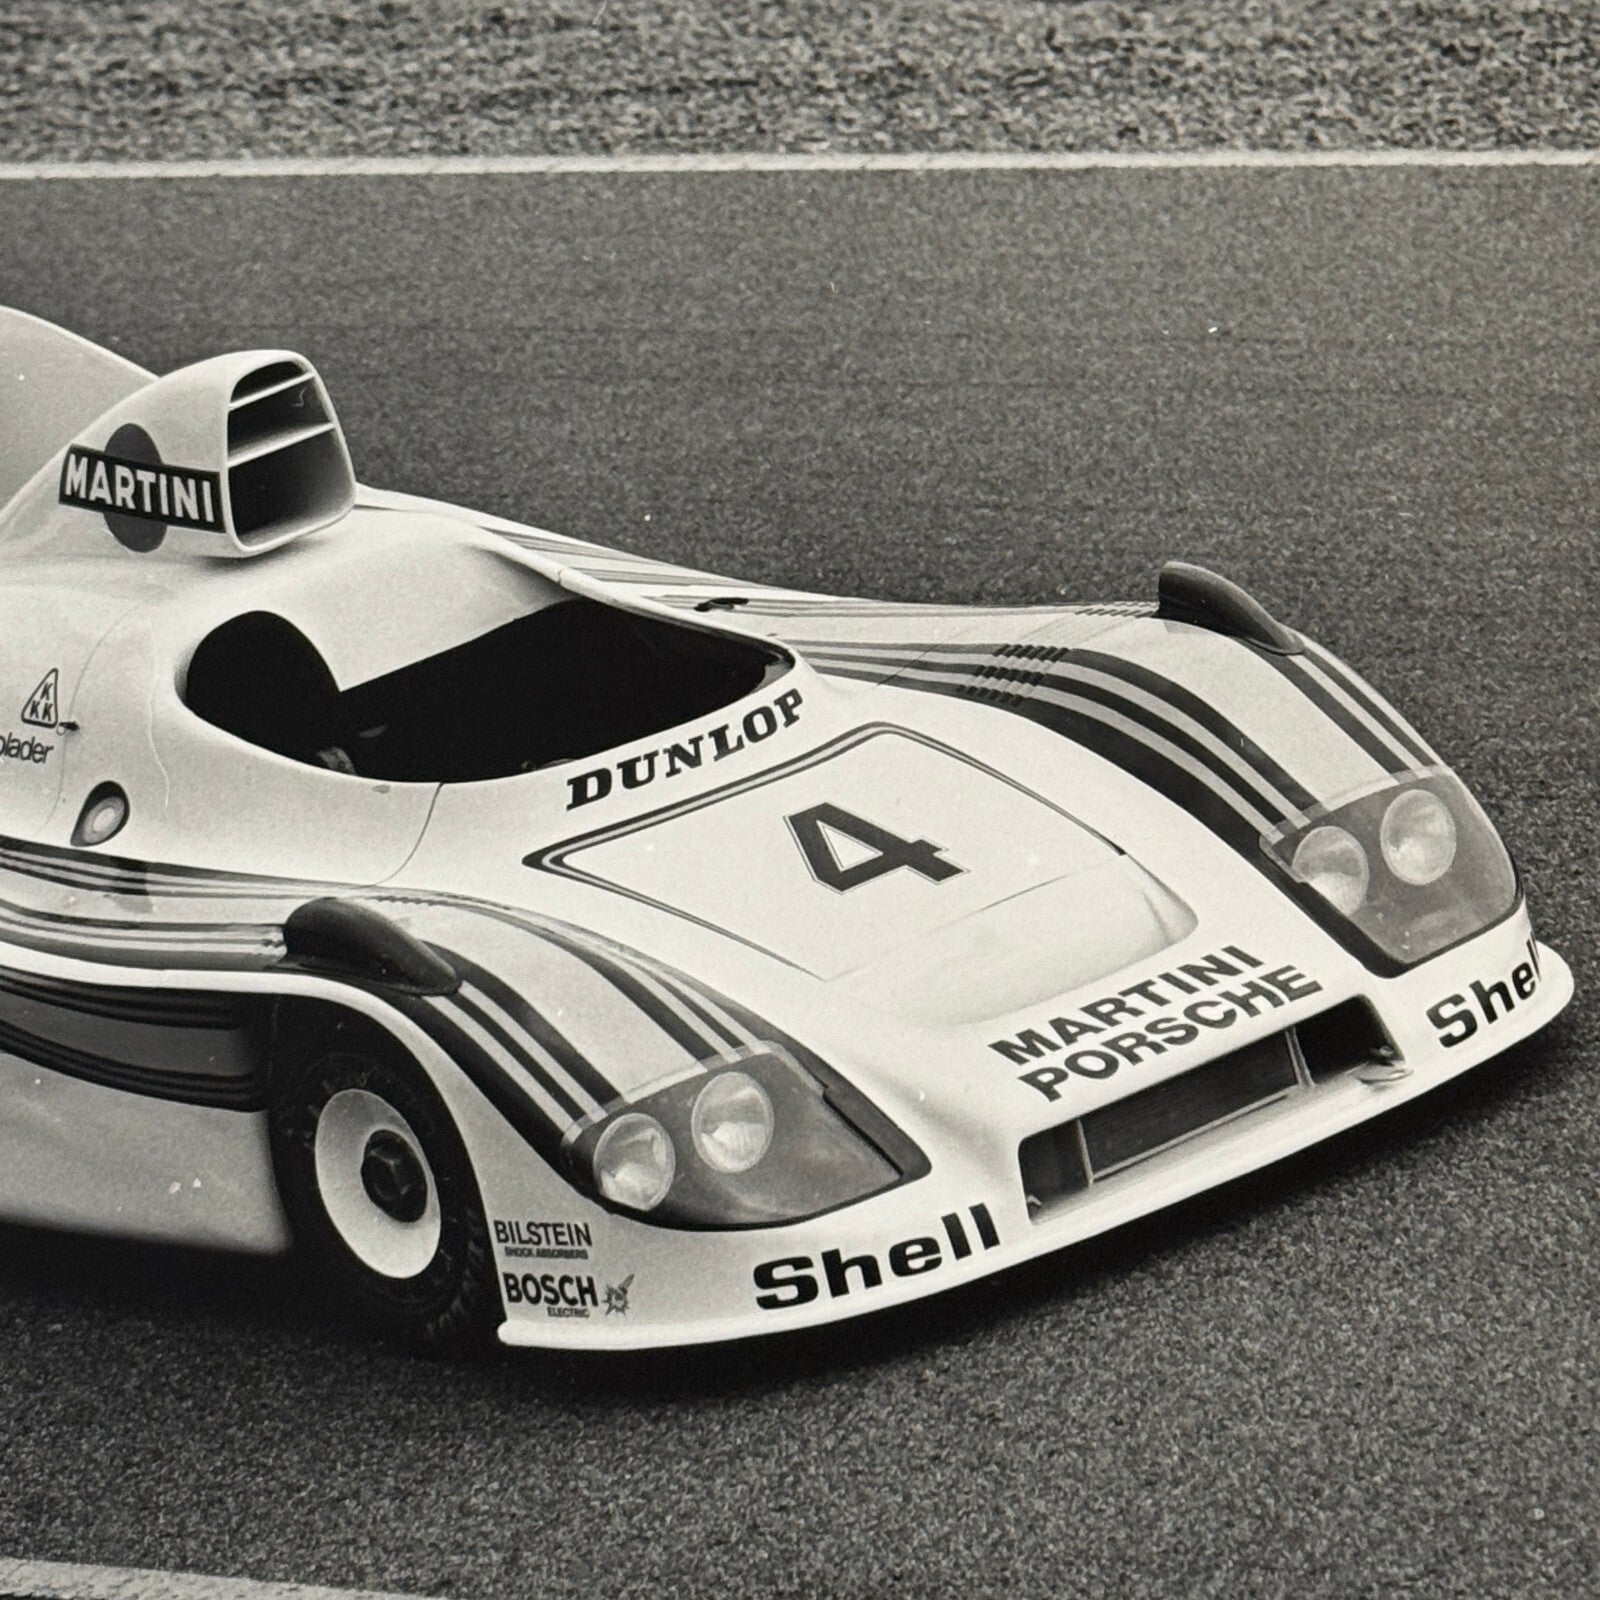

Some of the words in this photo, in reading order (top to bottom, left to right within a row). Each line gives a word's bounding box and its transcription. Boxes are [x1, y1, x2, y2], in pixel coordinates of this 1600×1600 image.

[65, 453, 214, 523] MARTINI
[566, 688, 803, 811] DUNLOP
[782, 802, 971, 895] 4
[988, 945, 1265, 1066] MARTINI
[1018, 965, 1324, 1103] PORSCHE
[494, 1220, 592, 1247] BILSTEIN
[753, 1202, 1001, 1310] Shell
[503, 1272, 598, 1307] BOSCH
